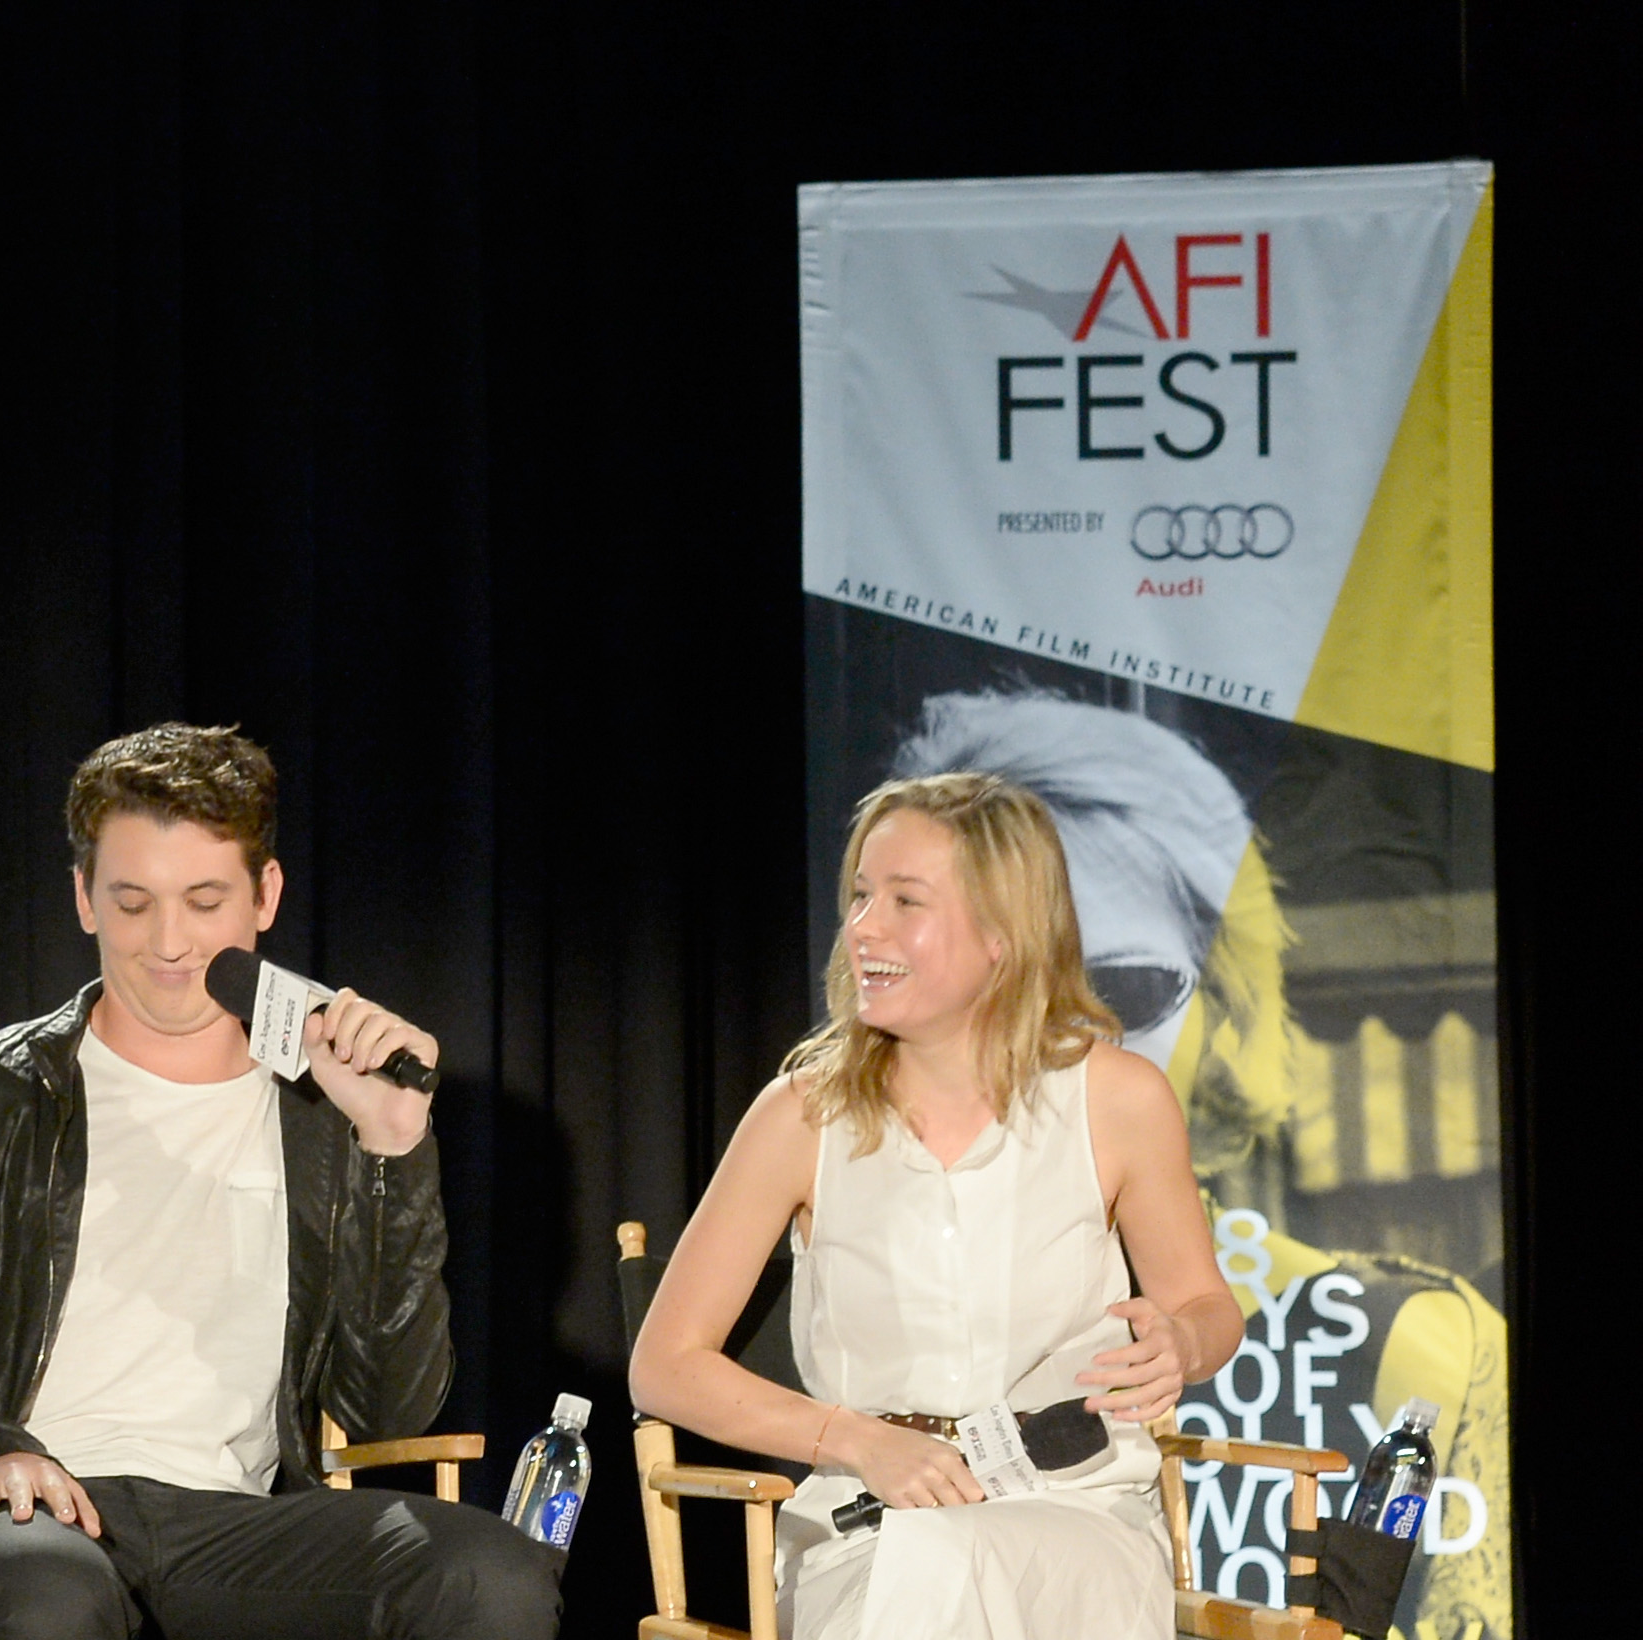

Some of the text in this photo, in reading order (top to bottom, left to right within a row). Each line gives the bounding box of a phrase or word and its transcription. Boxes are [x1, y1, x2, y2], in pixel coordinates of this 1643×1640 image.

[1072, 232, 1270, 342] AFI
[997, 351, 1297, 462] FEST
[998, 511, 1103, 534] PRESENTED BY
[1135, 578, 1204, 597] Audi
[836, 578, 1275, 709] AMERICAN FILM INSTITUTE
[1215, 1208, 1272, 1284] 8
[1215, 1339, 1344, 1417] OF
